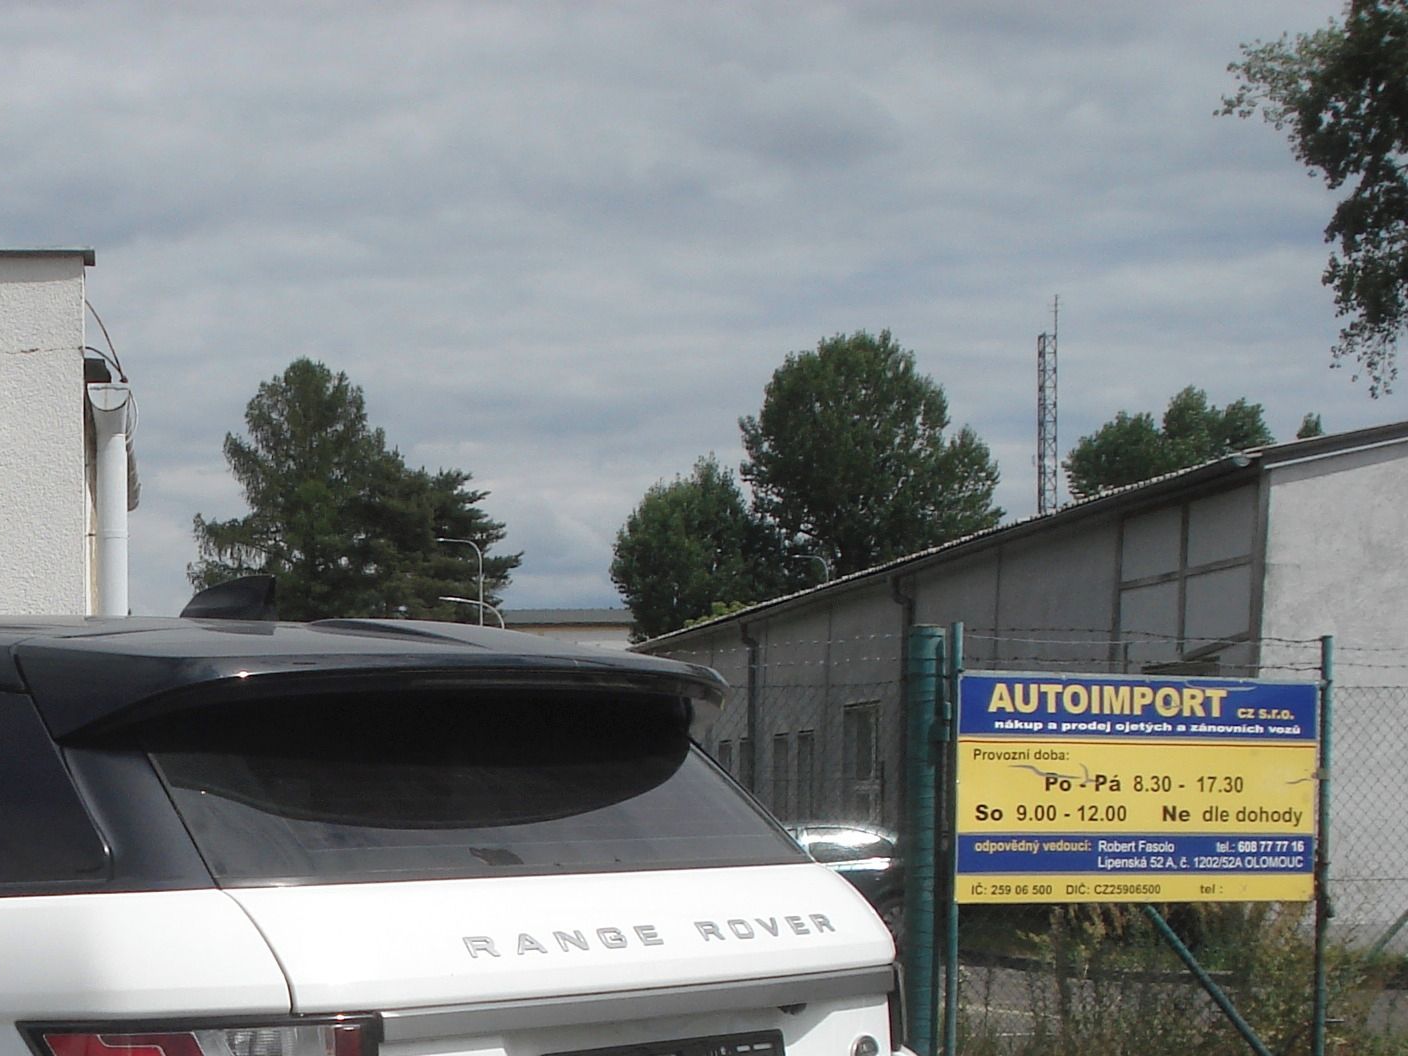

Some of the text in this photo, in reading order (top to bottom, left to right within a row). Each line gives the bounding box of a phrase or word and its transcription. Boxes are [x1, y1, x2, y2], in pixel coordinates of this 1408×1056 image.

[988, 683, 1227, 717] AUTOIMPORT
[1258, 709, 1295, 720] s.r.o.
[994, 720, 1043, 730] nákup
[1047, 722, 1058, 730] a
[1061, 721, 1111, 733] prodej
[1115, 722, 1172, 733] ojetých
[1190, 724, 1264, 734] zánovních
[1268, 725, 1301, 735] vozů
[973, 749, 1070, 761] Provozní doba:
[1045, 776, 1072, 792] Po
[1094, 774, 1121, 792] Pá
[1133, 775, 1172, 792] 8.30
[1197, 776, 1244, 793] 17.30
[975, 804, 1003, 821] So
[1016, 805, 1056, 821] 9.00
[1077, 805, 1127, 822] 12.00
[1162, 806, 1191, 822] Ne
[1202, 806, 1230, 822] dle
[1235, 807, 1303, 827] dohody
[1098, 840, 1136, 853] Robert
[1138, 840, 1175, 853] Fasolo
[1237, 841, 1257, 852] 608
[1260, 841, 1273, 852] 77
[1275, 841, 1289, 852] 77
[1291, 841, 1305, 852] 16
[1097, 856, 1148, 870] Lipenská
[1150, 857, 1163, 868] 52
[1194, 857, 1243, 868] 1202/52A
[1244, 857, 1304, 868] OLOMOUC
[971, 882, 987, 895] IČ:
[990, 885, 1011, 895] 259
[1014, 885, 1029, 895] 06
[1032, 885, 1053, 895] 500
[1066, 882, 1090, 895] DIČ:
[1094, 884, 1161, 895] CZ25906500
[462, 913, 836, 959] RANGE ROVER
